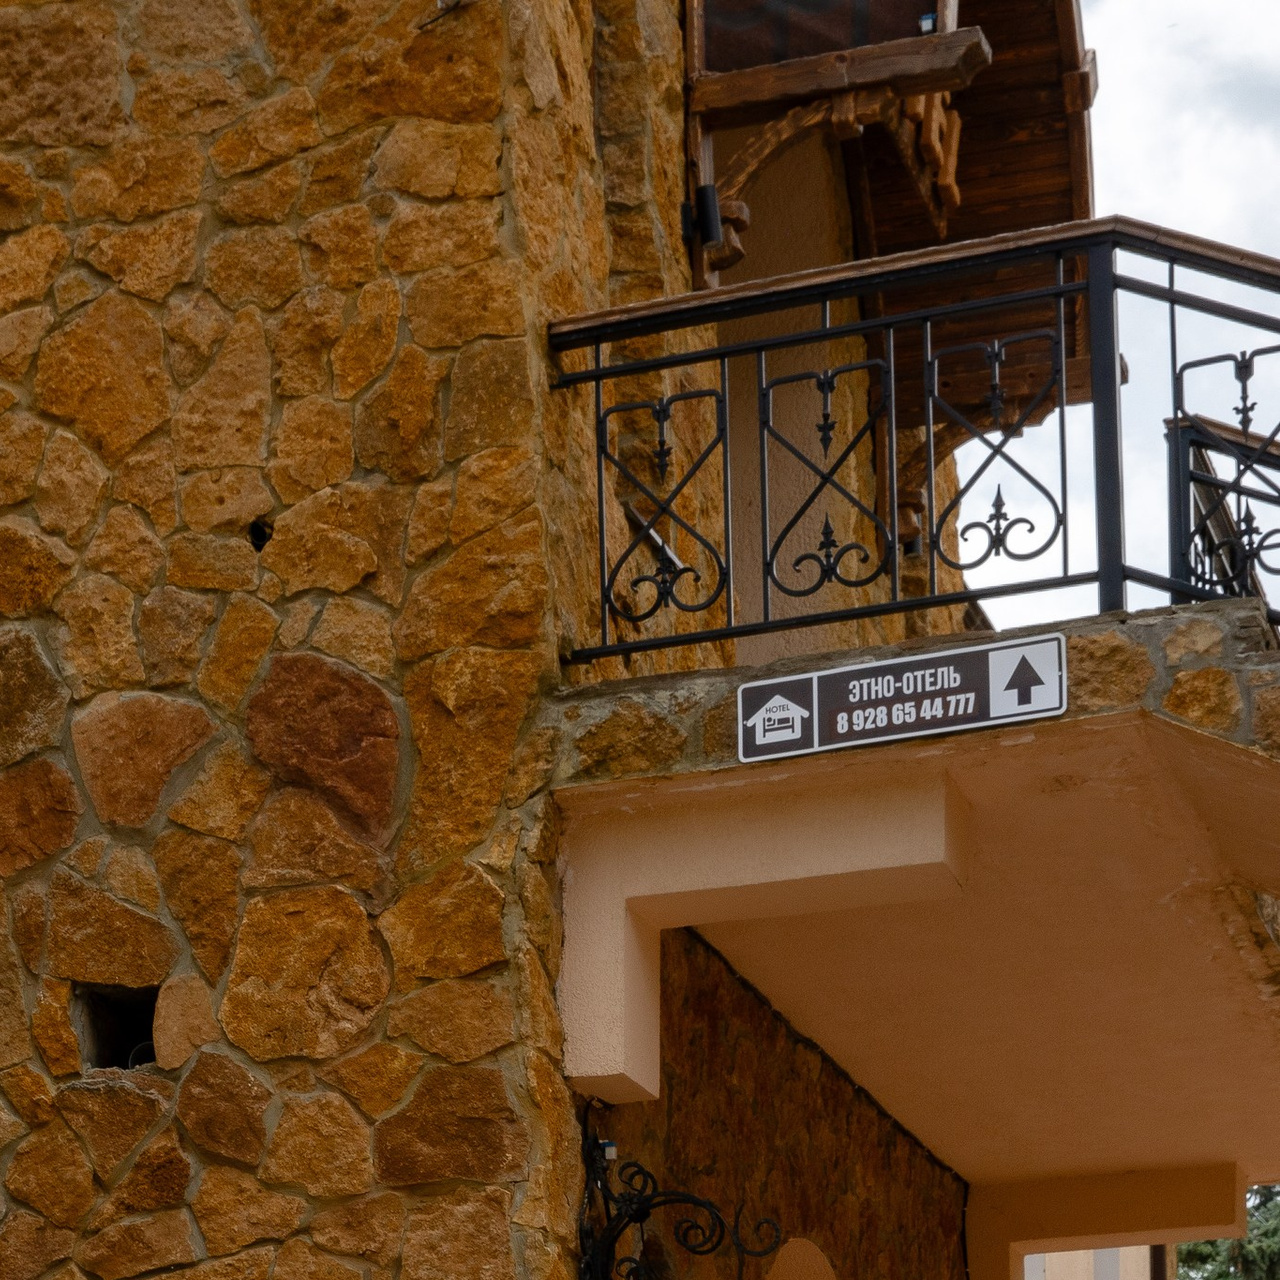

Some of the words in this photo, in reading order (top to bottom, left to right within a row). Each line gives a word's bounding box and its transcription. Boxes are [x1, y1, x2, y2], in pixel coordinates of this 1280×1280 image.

[848, 665, 961, 703] ЭТНО-ОТЕЛЬ
[765, 704, 790, 715] HOTEL
[836, 713, 849, 734] 8
[852, 709, 889, 732] 928
[891, 704, 916, 725] 65
[920, 698, 945, 720] 44
[947, 692, 976, 714] 777
